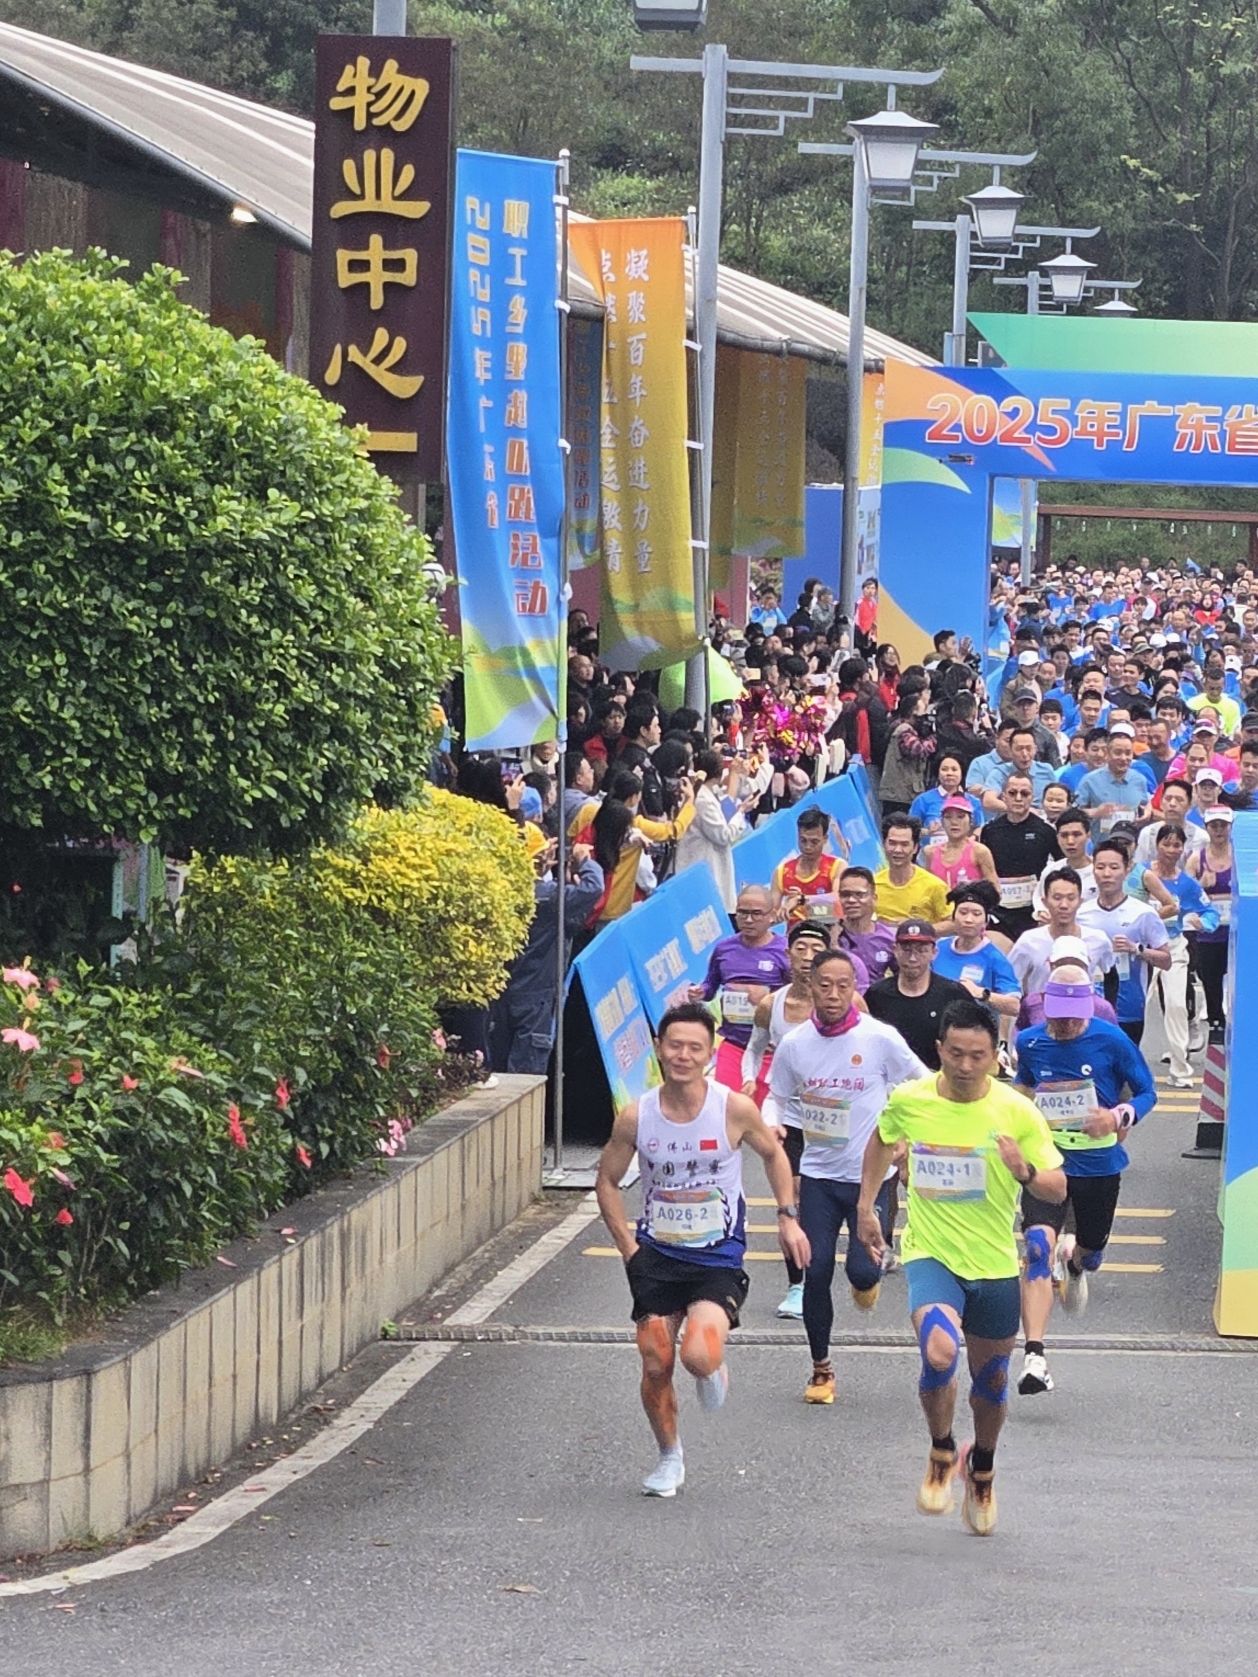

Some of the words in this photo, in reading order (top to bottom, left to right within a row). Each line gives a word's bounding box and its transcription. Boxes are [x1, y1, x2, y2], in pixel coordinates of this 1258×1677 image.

[325, 55, 431, 399] 物业中心
[625, 248, 653, 574] 凝聚百年奋进力量
[1040, 1094, 1085, 1110] A024-2
[916, 1159, 970, 1177] A024-1
[656, 1206, 708, 1221] A026-2
